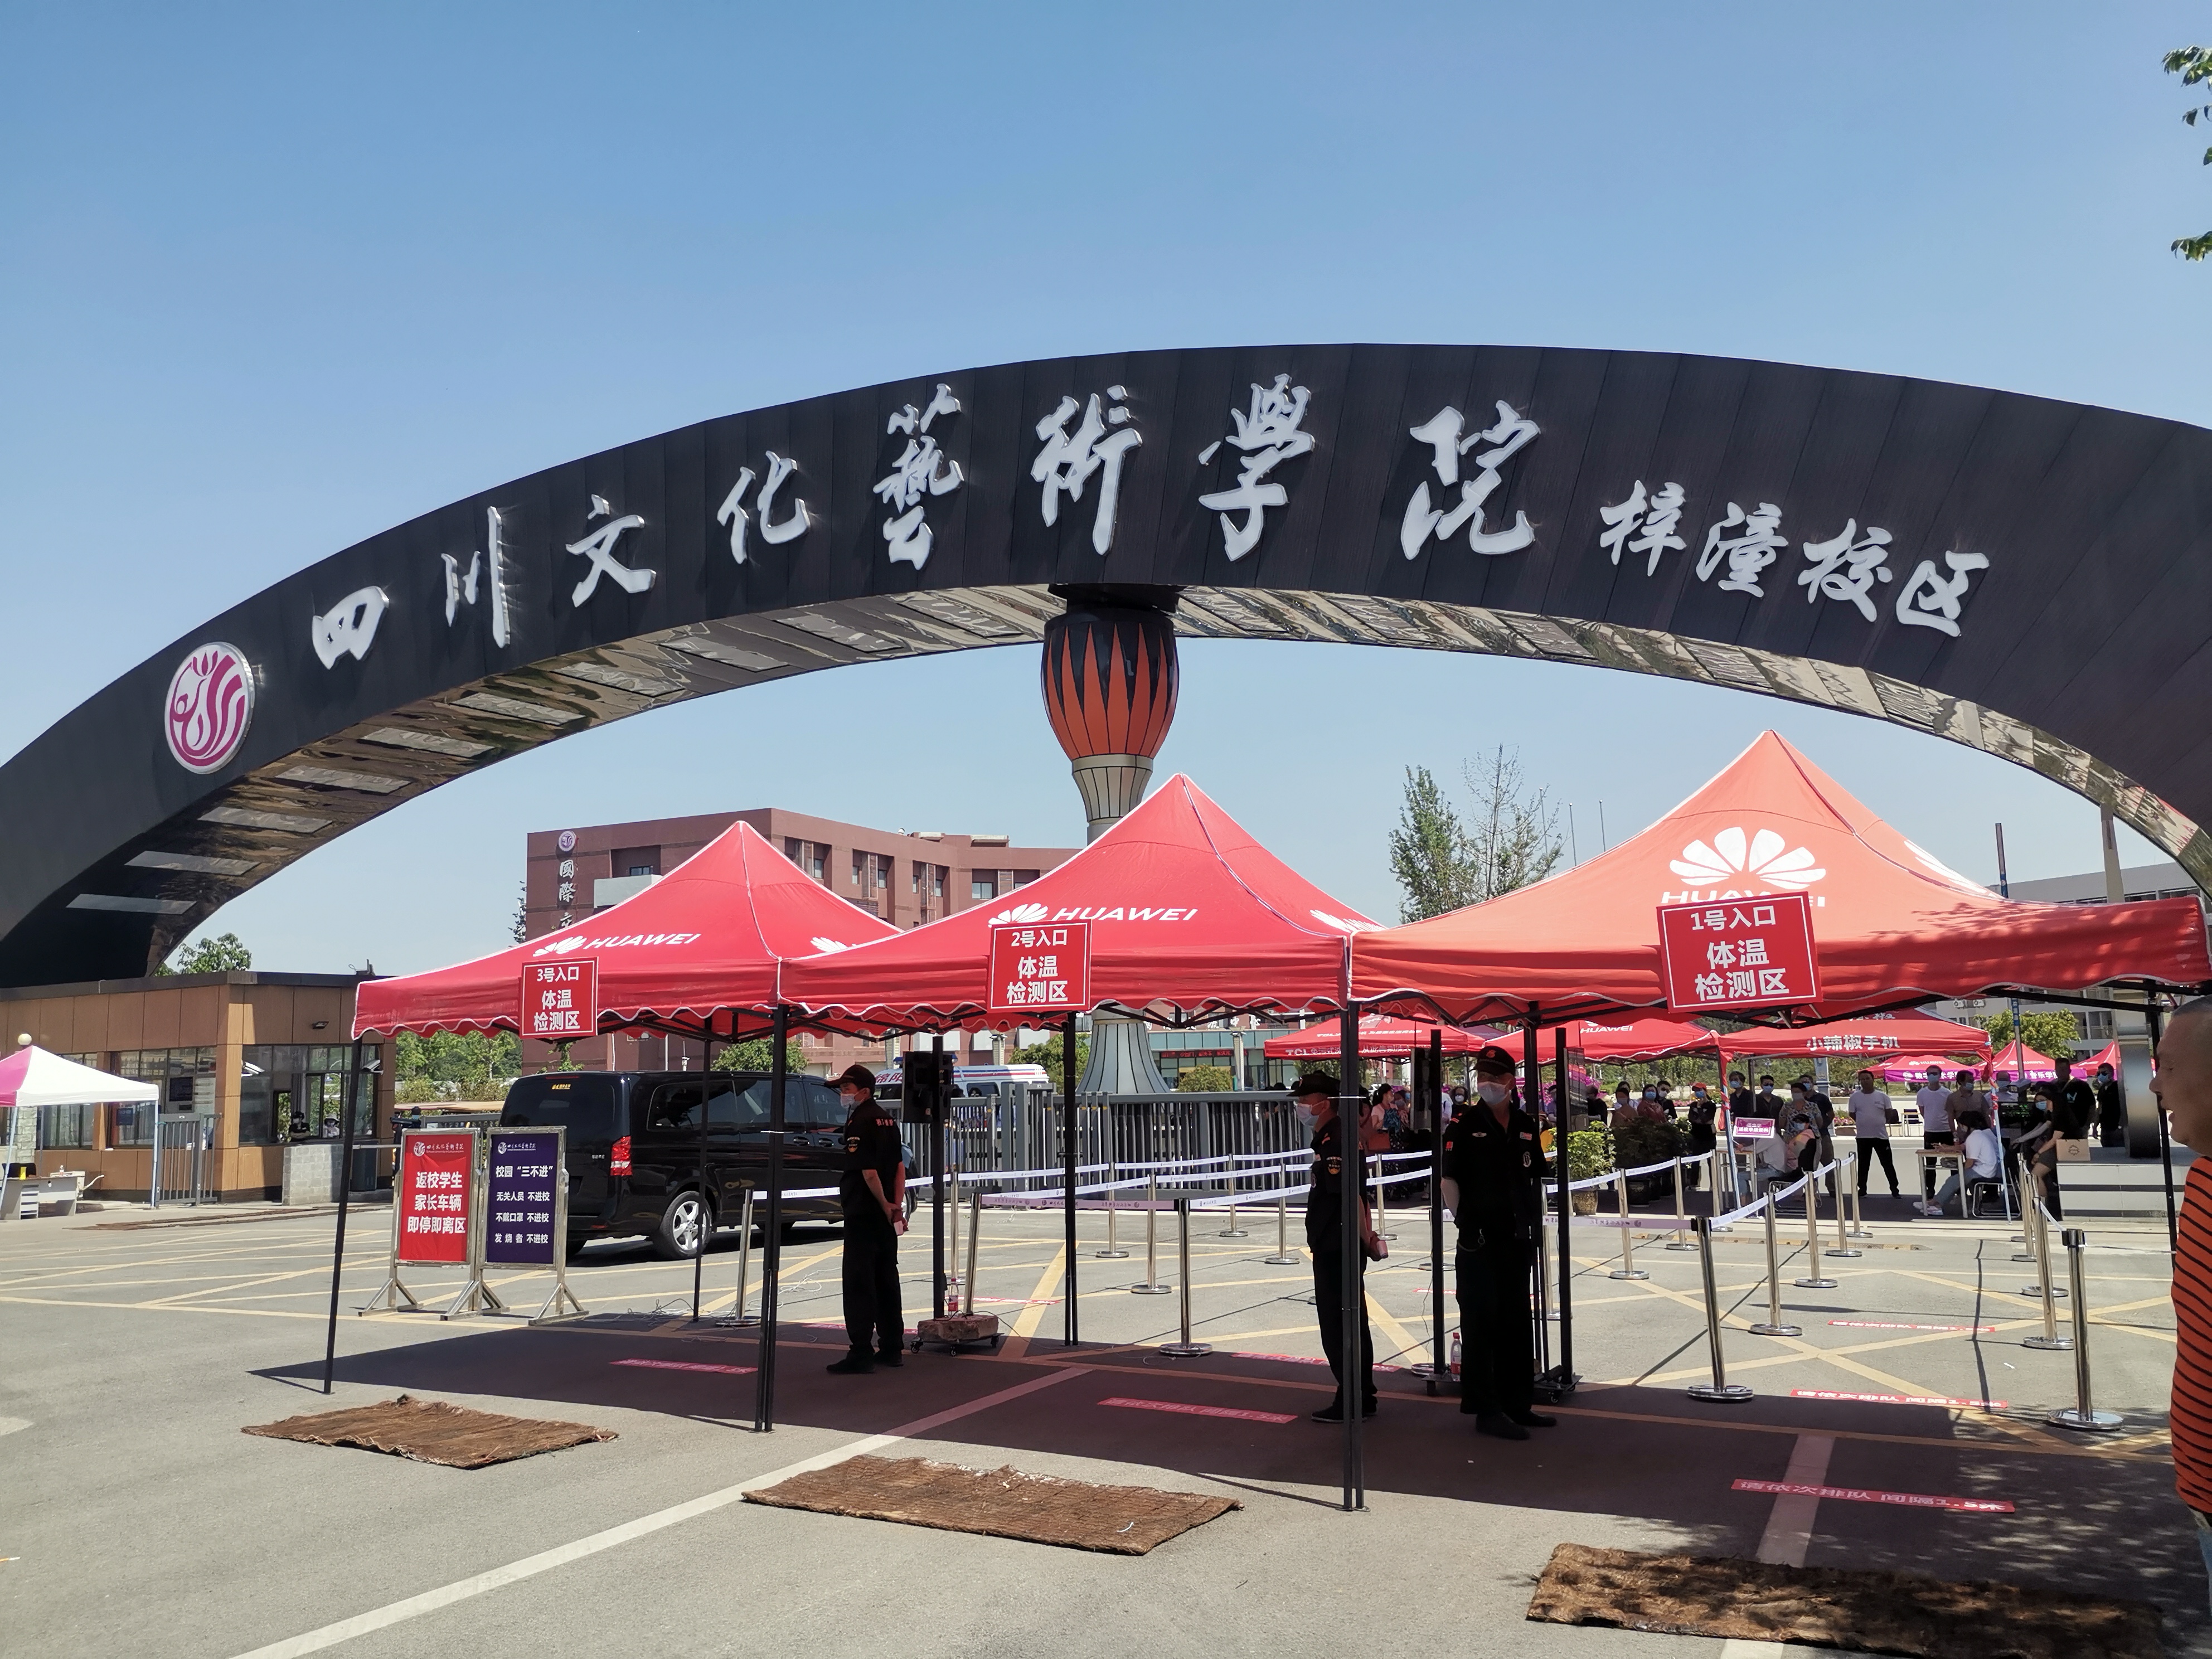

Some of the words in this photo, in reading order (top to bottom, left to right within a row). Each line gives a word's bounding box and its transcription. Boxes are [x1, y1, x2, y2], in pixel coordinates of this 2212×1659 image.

[1051, 907, 1198, 921] HUAWEI
[1691, 905, 1776, 931] 1号入口
[583, 934, 701, 949] HUAWEI
[1012, 930, 1067, 947] 2号入口
[1707, 939, 1769, 969] 体温
[537, 967, 579, 983] 3号入口
[1018, 955, 1058, 979] 体温
[1007, 981, 1068, 1005] 检测区
[1695, 968, 1789, 1002] 检测区
[542, 989, 572, 1010] 体温
[533, 1012, 580, 1032] 检测区
[1806, 1035, 1900, 1051] 小辣椒手机
[416, 1171, 463, 1189] 返校学生
[496, 1166, 513, 1177] 校园
[414, 1194, 462, 1211] 家长车辆
[496, 1191, 524, 1201] 无关人员
[527, 1191, 550, 1201] 不进校
[407, 1216, 466, 1234] 即停即离区
[496, 1212, 523, 1222] 不戴口罩
[527, 1212, 549, 1223] 不进校
[526, 1234, 549, 1244] 不进校
[1740, 1481, 1871, 1500] 请依次排队
[1880, 1493, 2006, 1511] 间隔1.5米
